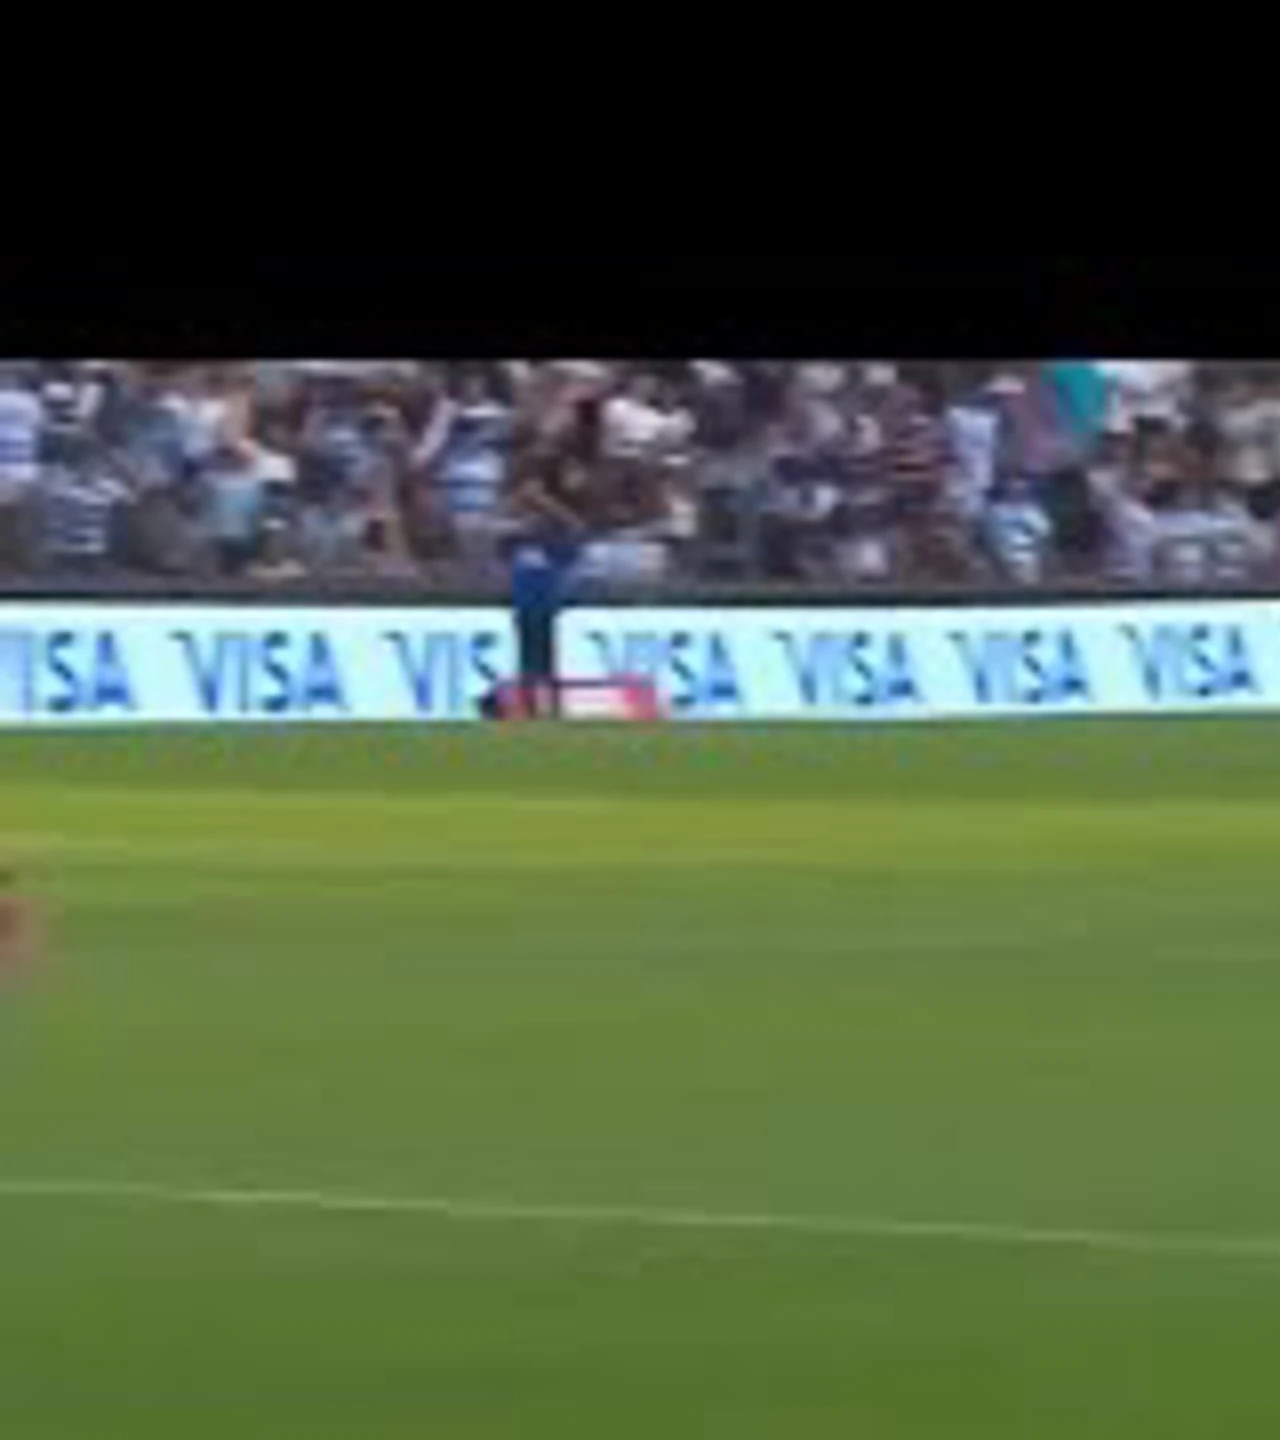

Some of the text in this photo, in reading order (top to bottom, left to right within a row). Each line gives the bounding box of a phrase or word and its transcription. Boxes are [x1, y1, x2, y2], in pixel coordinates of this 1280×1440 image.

[168, 632, 348, 712] VISA
[383, 632, 512, 712] VIS
[588, 632, 752, 712] VISA
[775, 630, 922, 706] VISA
[948, 630, 1092, 704] VISA
[1120, 624, 1262, 698] VISA
